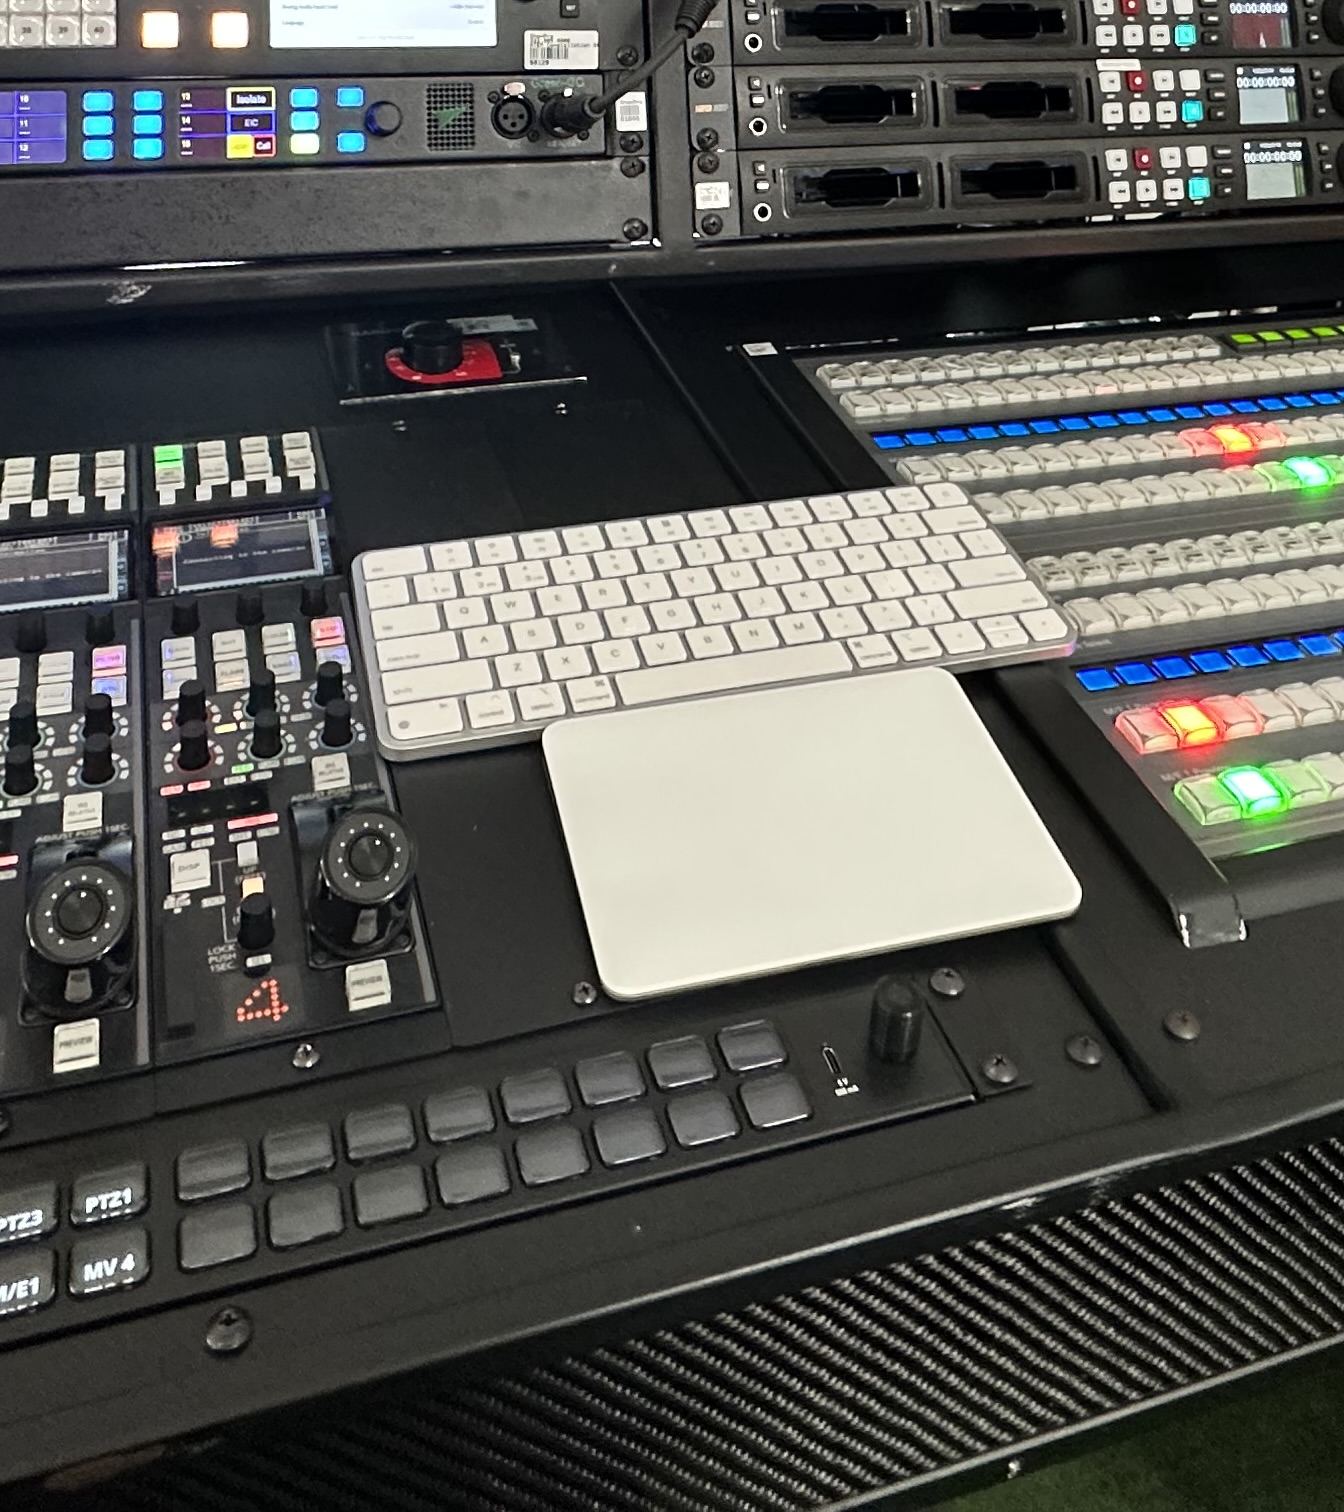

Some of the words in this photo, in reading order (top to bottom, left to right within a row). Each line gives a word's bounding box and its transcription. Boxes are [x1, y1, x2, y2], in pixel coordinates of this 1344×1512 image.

[20, 95, 29, 103] 10
[236, 93, 267, 105] Isolate
[19, 120, 28, 128] 11
[181, 116, 191, 125] 14
[19, 144, 29, 152] 12
[256, 141, 271, 151] Call
[731, 570, 740, 578] U
[687, 576, 695, 584] Y
[844, 585, 853, 593] L
[799, 591, 808, 599] K
[505, 601, 516, 609] W
[759, 598, 765, 606] J
[459, 607, 469, 615] Q
[712, 603, 722, 611] H
[621, 616, 628, 624] F
[576, 622, 585, 630] D
[793, 622, 805, 631] M
[749, 629, 759, 638] N
[480, 636, 489, 644] A
[656, 642, 665, 651] V
[610, 649, 621, 658] C
[561, 656, 571, 665] X
[514, 663, 522, 672] Z
[35, 831, 72, 844] ADJUST
[177, 862, 202, 872] DISP
[207, 944, 237, 956] LOCK
[208, 953, 237, 964] PUSH
[352, 975, 386, 990] PREVIEW
[235, 978, 290, 1023] 4
[60, 1035, 95, 1051] PREVIEW
[85, 1188, 133, 1213] PTZ1
[84, 1257, 117, 1282] MV
[118, 1253, 135, 1273] 4
